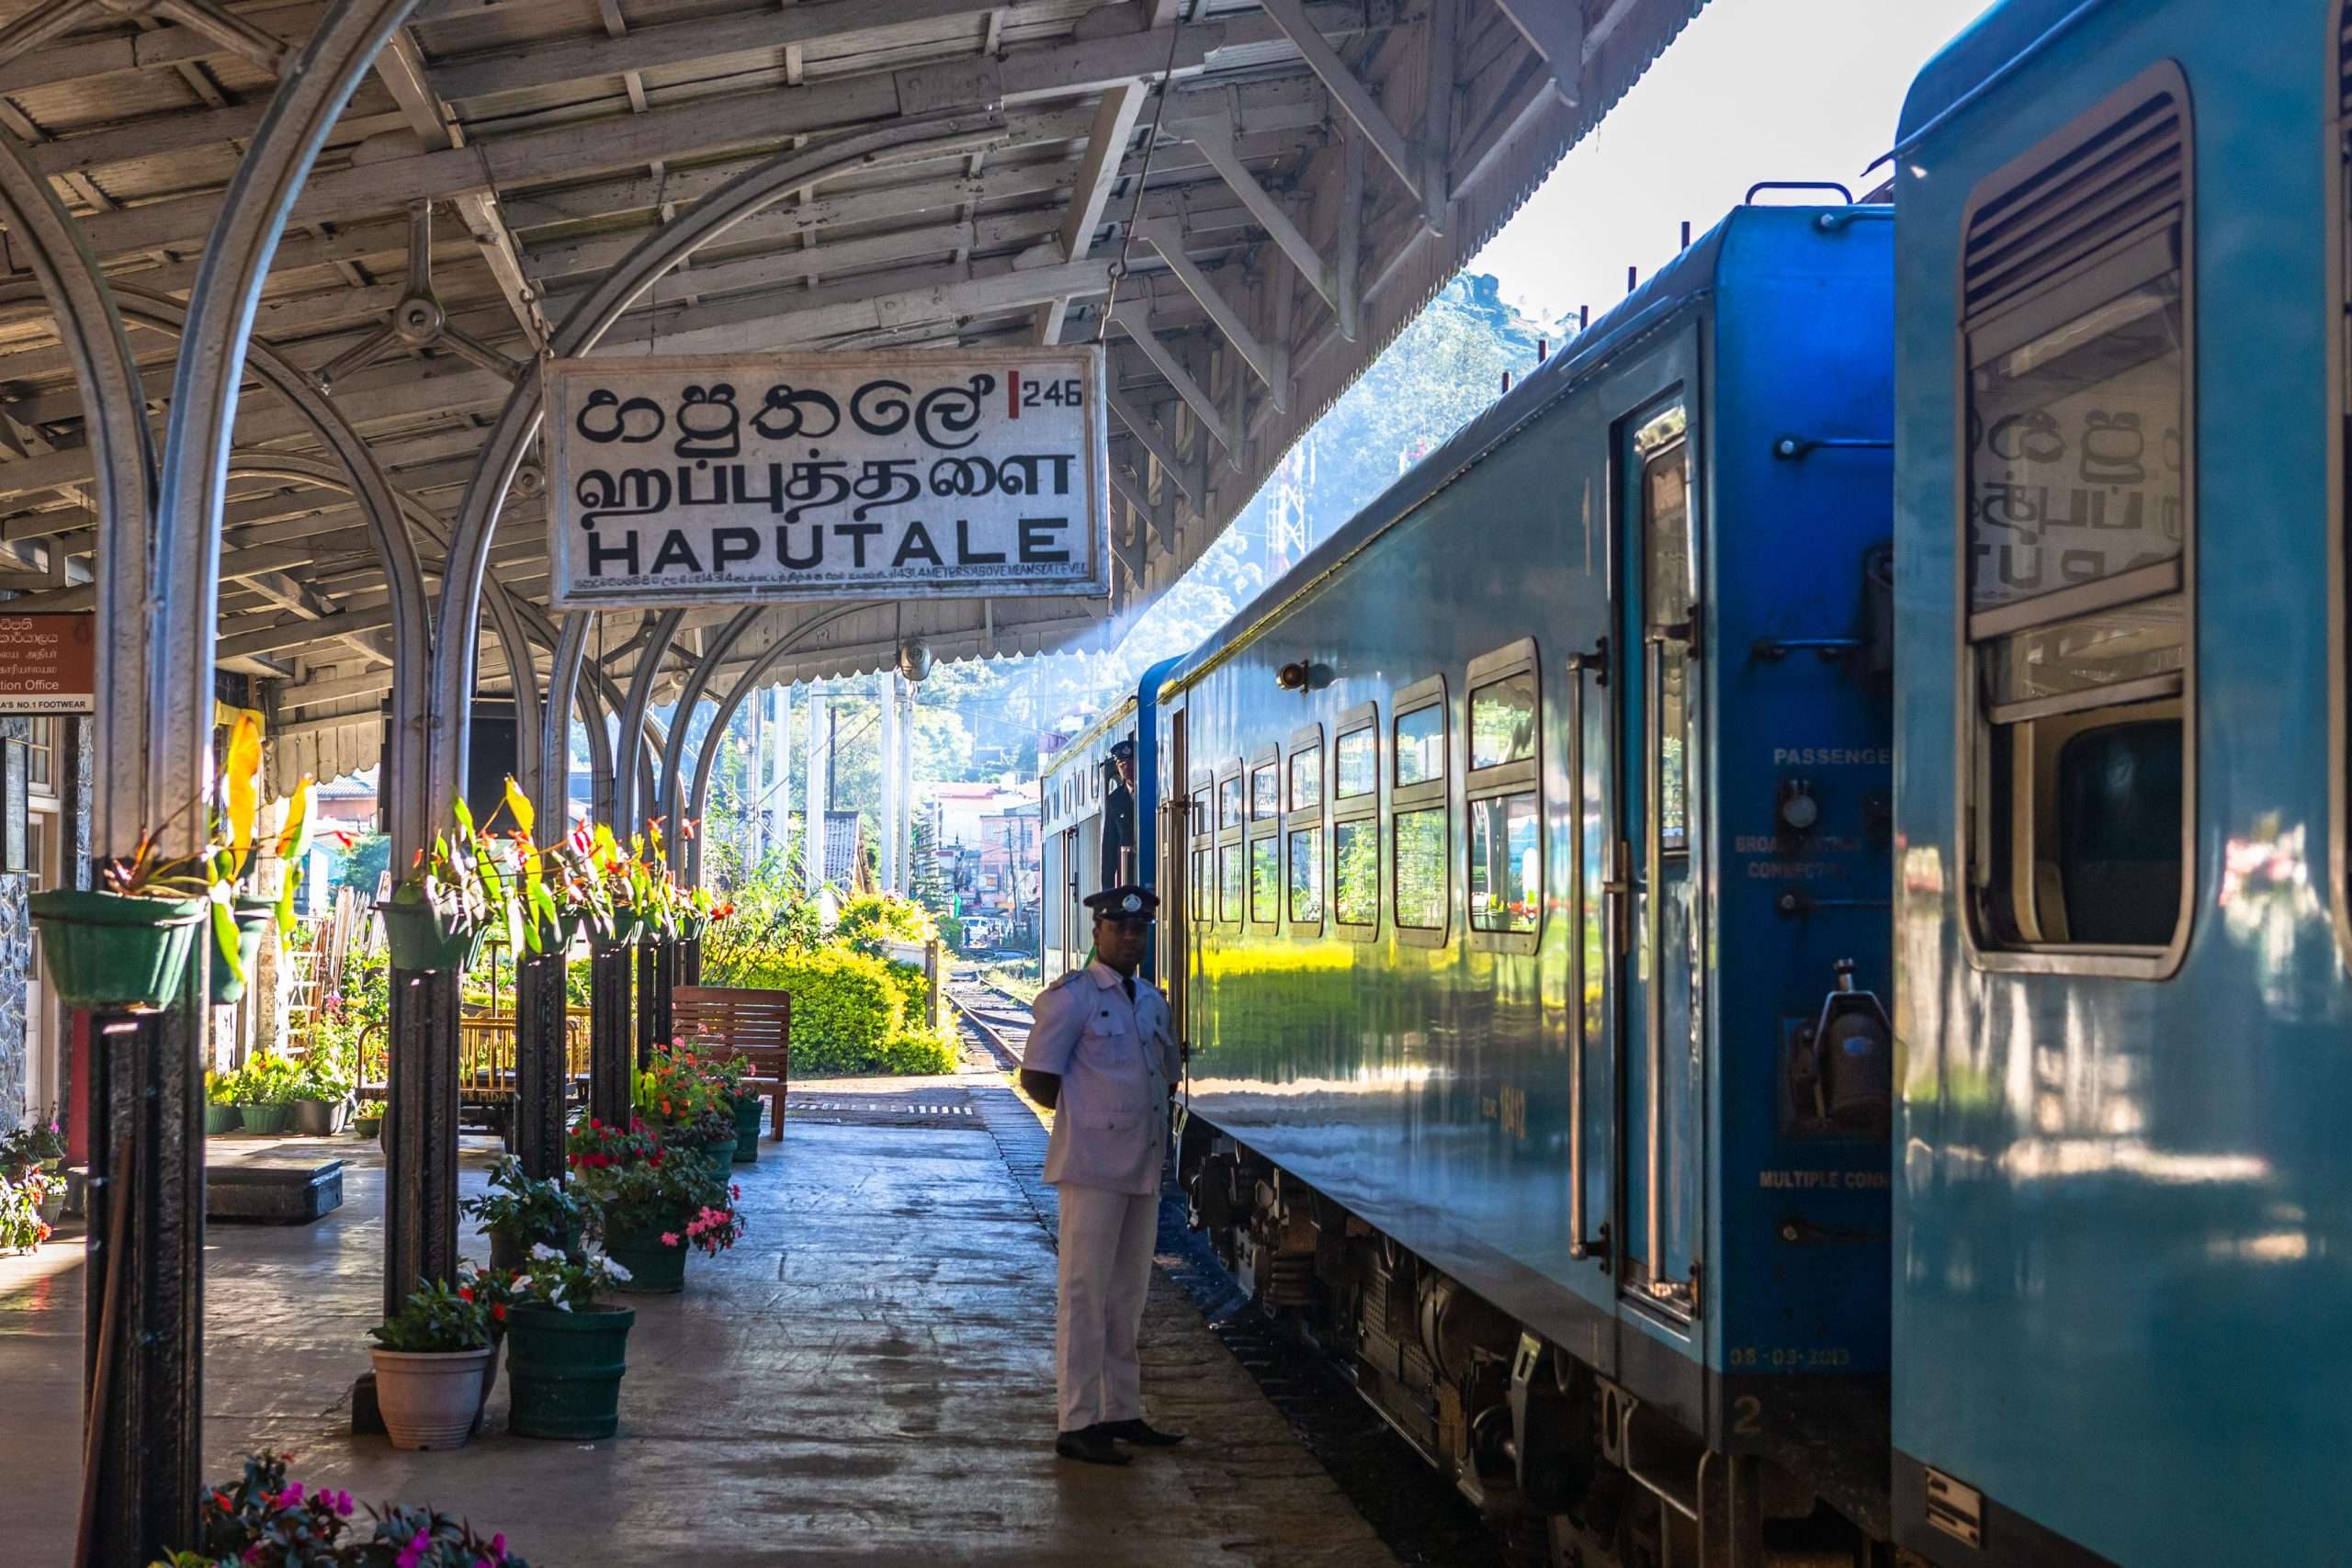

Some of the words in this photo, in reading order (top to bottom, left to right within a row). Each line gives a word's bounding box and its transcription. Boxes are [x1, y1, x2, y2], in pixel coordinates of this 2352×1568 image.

[576, 448, 1076, 528] ஹப்புத்தளை
[588, 517, 1070, 576] HAPUTALE
[25, 680, 59, 691] Office
[38, 700, 86, 708] FOOTWEAR
[1774, 749, 1892, 764] PASSENGE
[1759, 1170, 1838, 1188] MULTIPLE
[1734, 1395, 1762, 1433] 2
